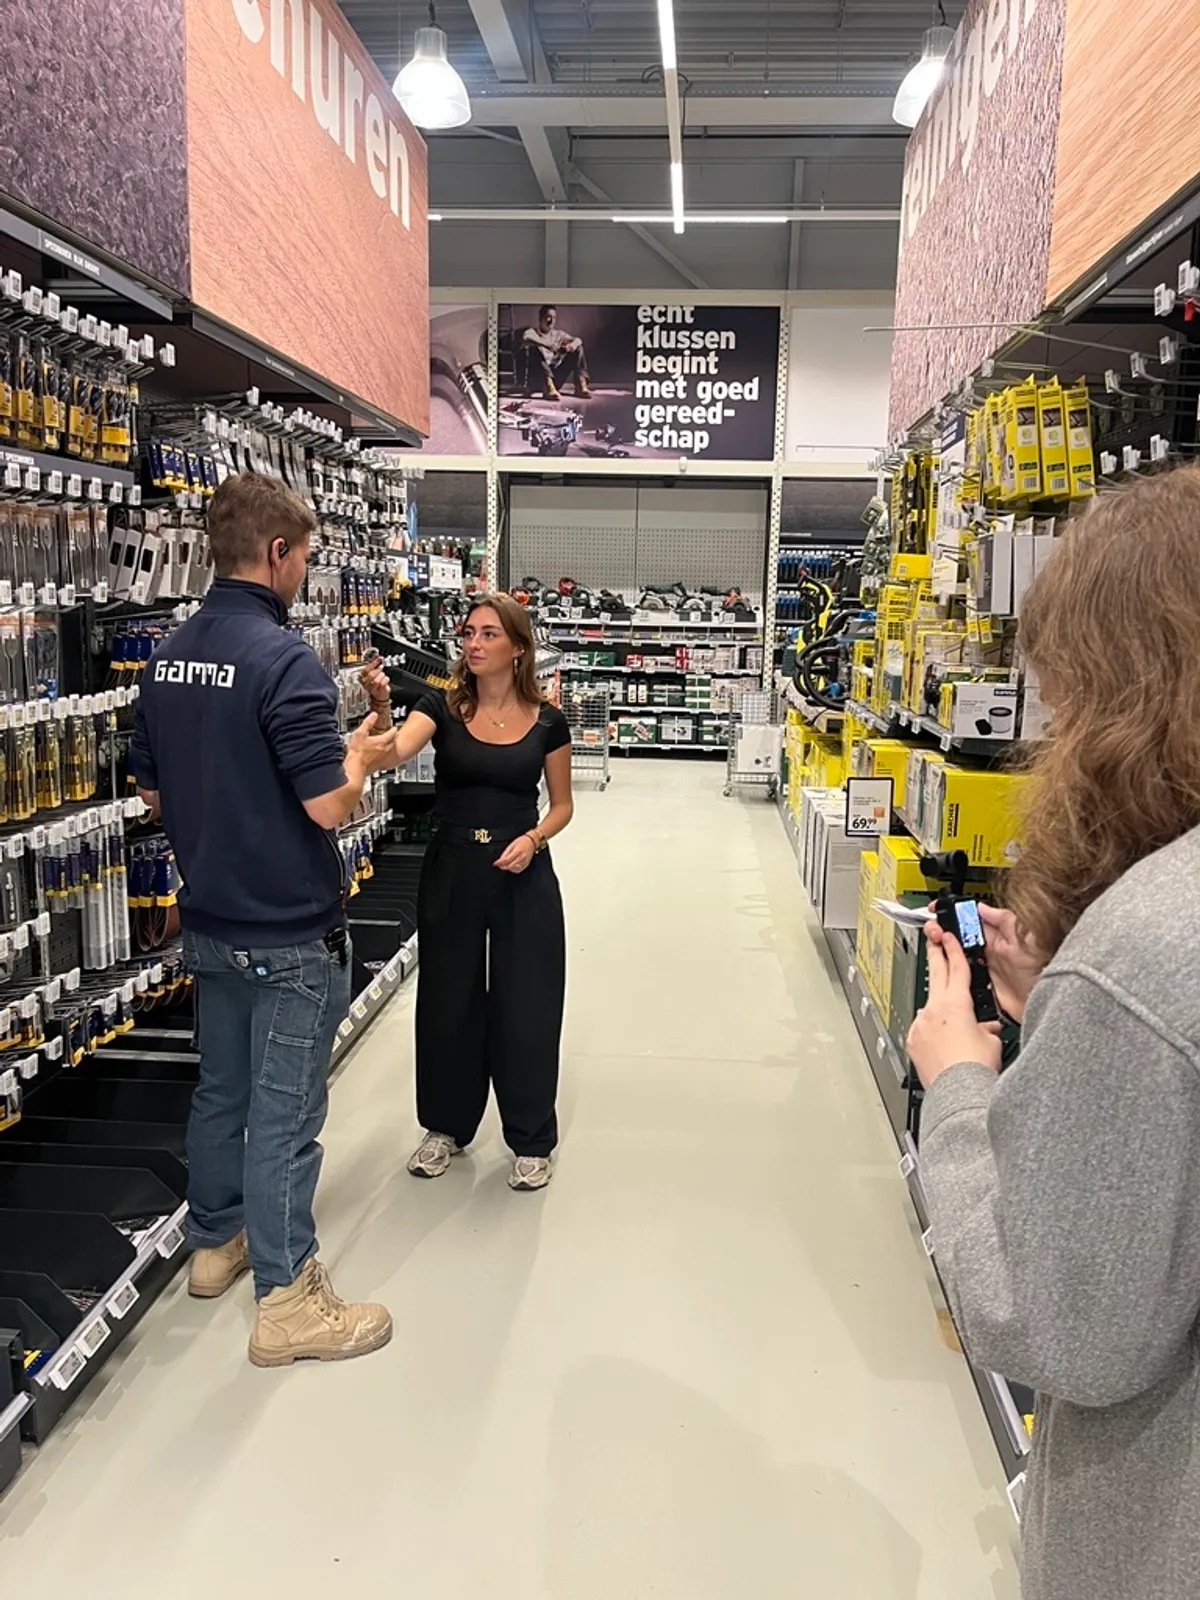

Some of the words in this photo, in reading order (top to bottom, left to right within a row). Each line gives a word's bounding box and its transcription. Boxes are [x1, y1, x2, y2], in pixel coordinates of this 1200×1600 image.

[637, 325, 736, 349] klussen
[636, 350, 719, 379] begint
[635, 376, 687, 399] met
[696, 376, 759, 404] goed
[634, 401, 736, 428] gereed-
[634, 424, 710, 453] schap
